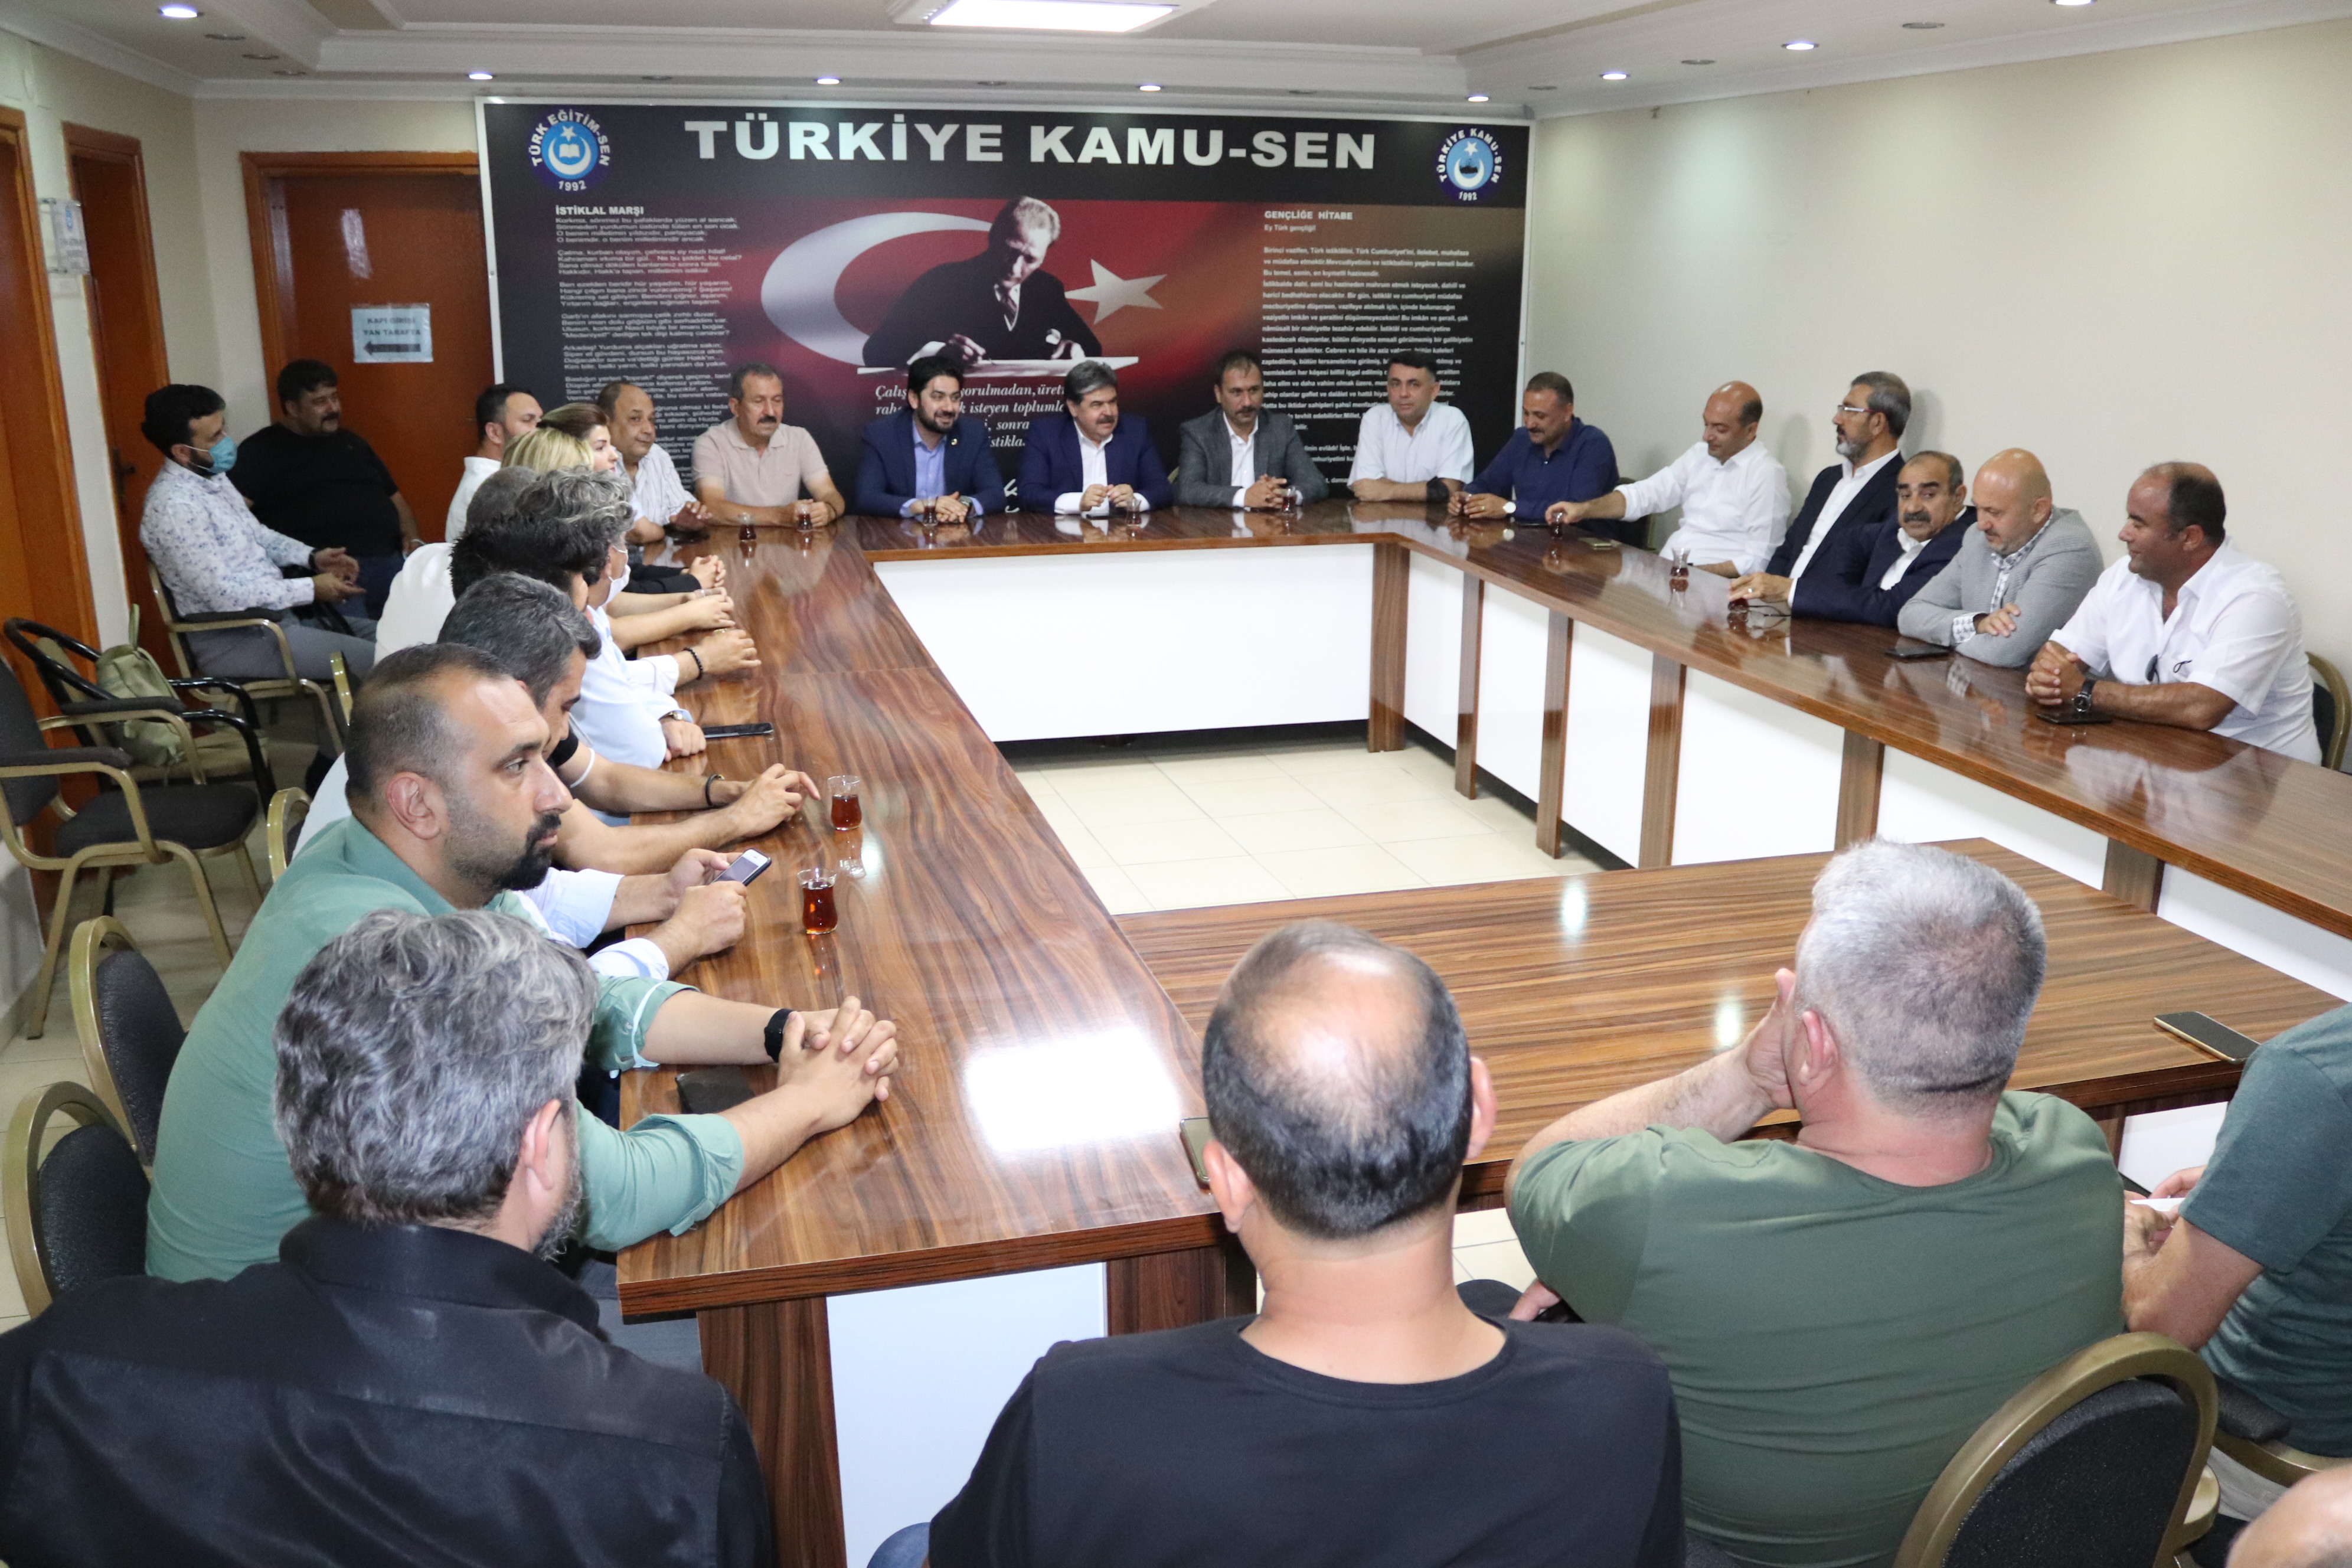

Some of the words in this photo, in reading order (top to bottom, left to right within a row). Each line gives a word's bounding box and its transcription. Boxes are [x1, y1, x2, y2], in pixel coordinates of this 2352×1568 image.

[529, 123, 548, 166] TÜRK
[547, 109, 610, 166] EĞİTİM-SEN
[685, 113, 1003, 162] TÜRKİYE
[1030, 125, 1374, 169] KAMU-SEN
[1436, 130, 1465, 182] TÜRKİYE
[558, 180, 586, 191] 1992
[1459, 191, 1477, 201] 1992
[556, 205, 606, 215] İSTİKLAL
[609, 206, 644, 217] MARŞI
[1265, 210, 1313, 220] GENÇLİĞE
[1318, 211, 1353, 220] HİTABE
[970, 402, 1009, 417] isteyen
[997, 420, 1030, 430] sonra
